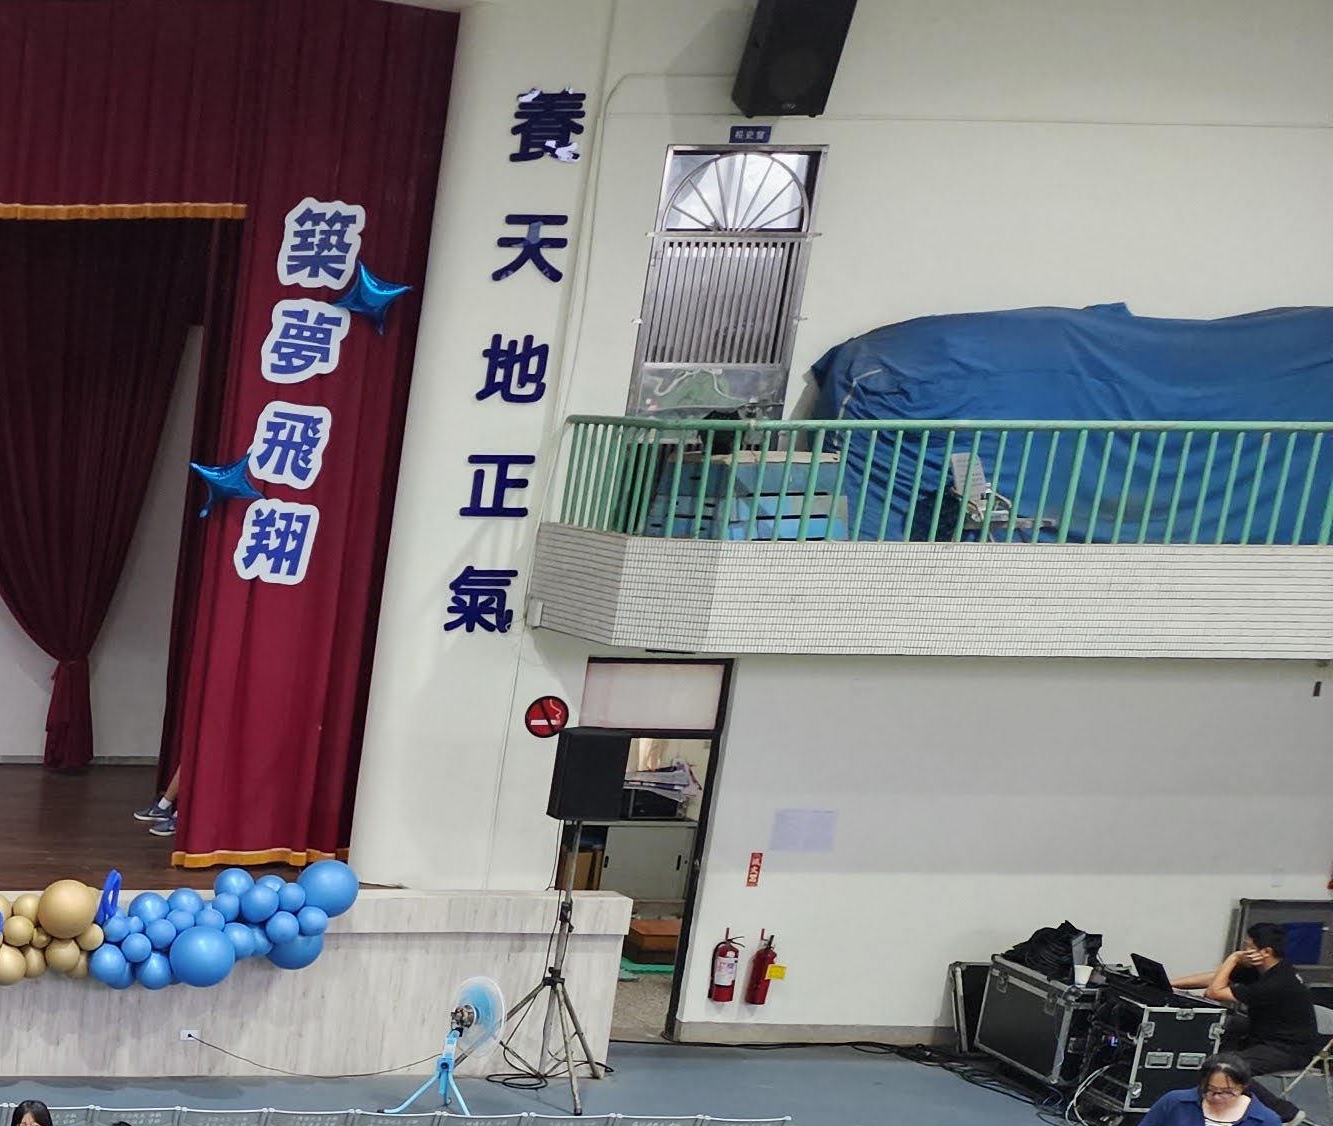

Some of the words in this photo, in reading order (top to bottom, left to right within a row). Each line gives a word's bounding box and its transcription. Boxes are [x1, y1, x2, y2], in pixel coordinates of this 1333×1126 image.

[241, 207, 358, 577] 築夢飛翔
[443, 88, 586, 634] 養天地正氣
